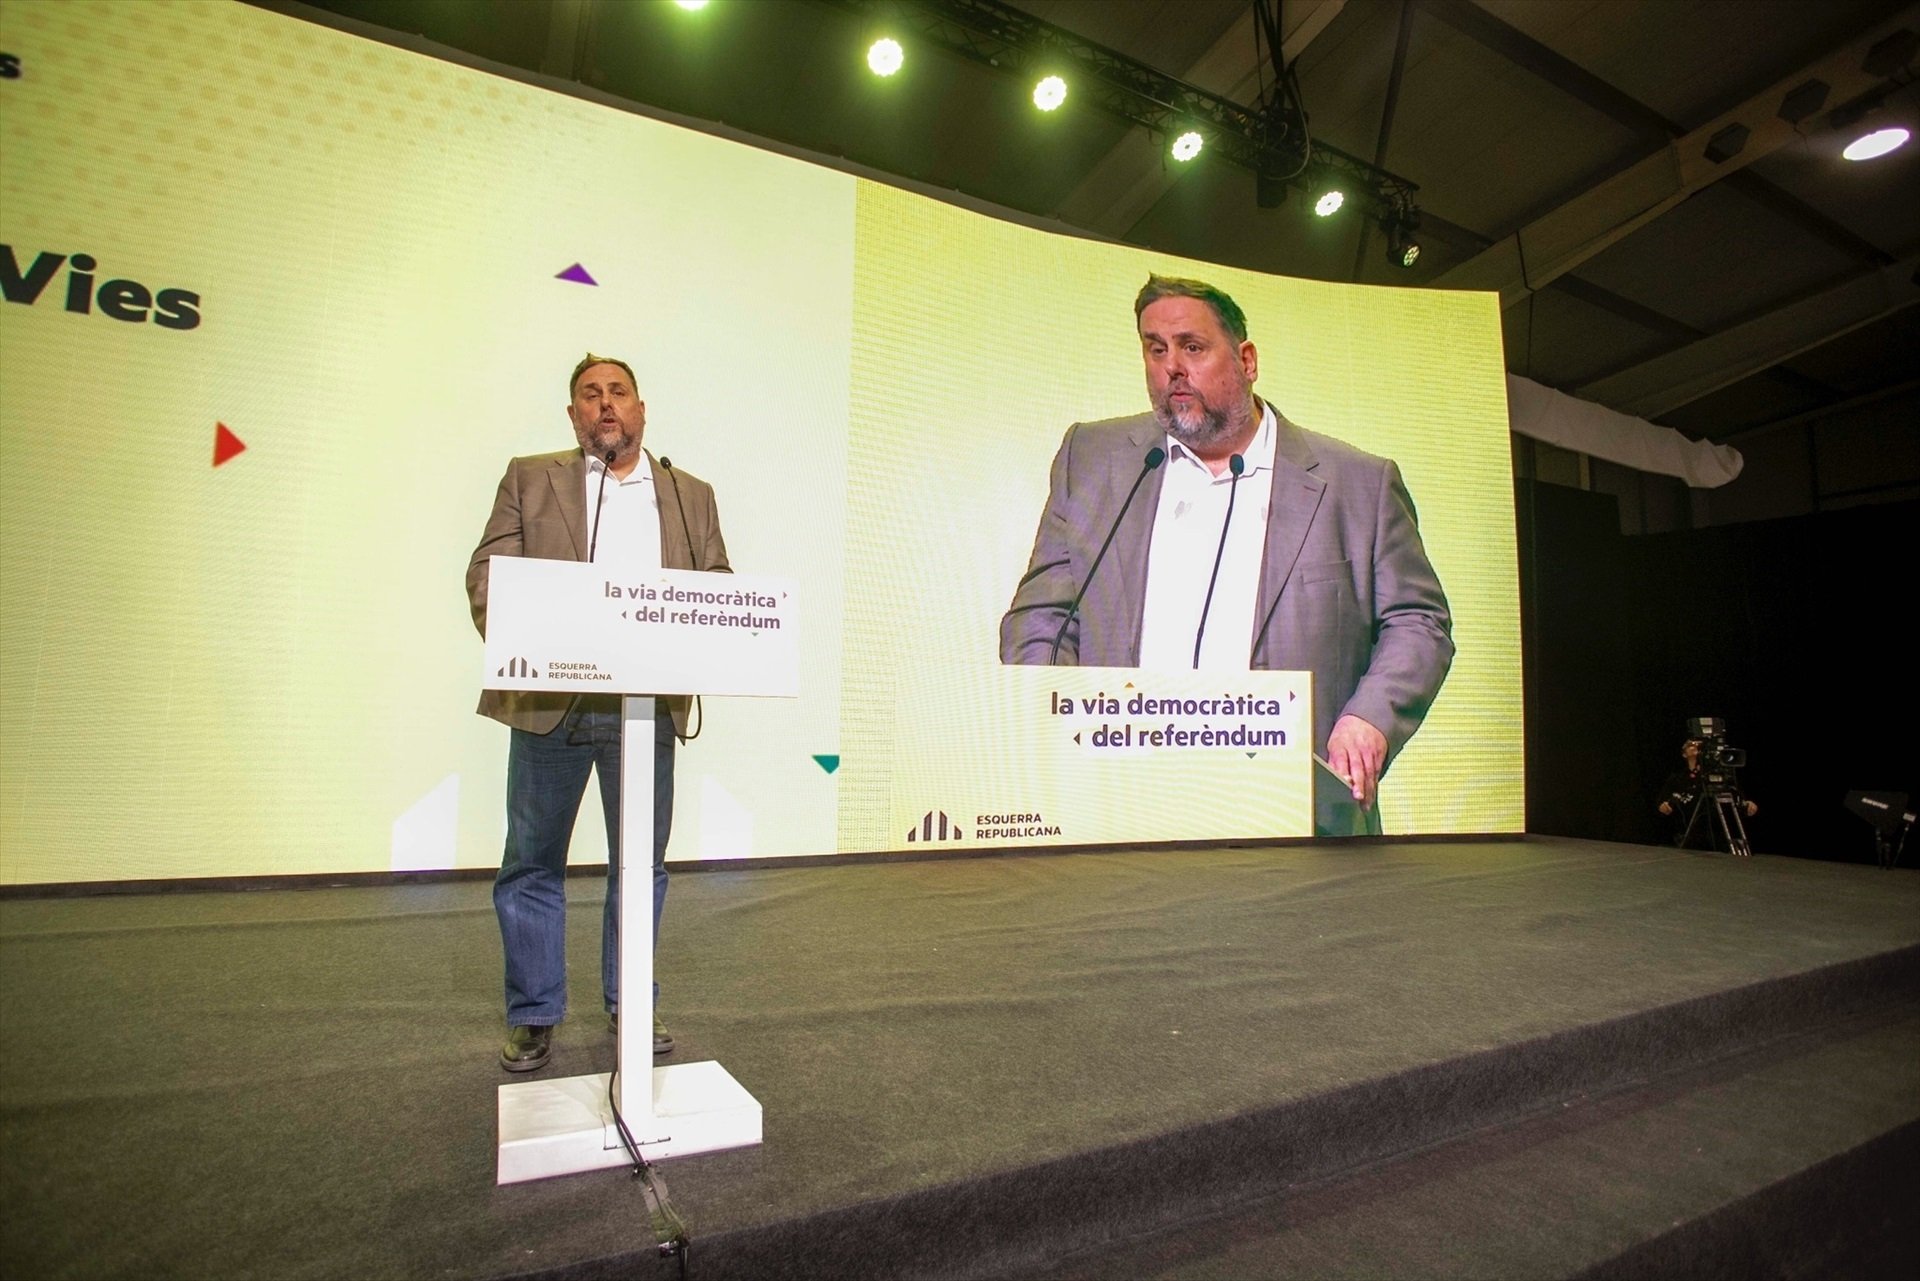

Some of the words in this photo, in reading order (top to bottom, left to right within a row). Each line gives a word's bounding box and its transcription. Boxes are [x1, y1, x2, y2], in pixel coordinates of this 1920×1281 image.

[0, 243, 201, 331] Vies
[605, 580, 622, 599] la
[627, 583, 657, 601] via
[661, 585, 777, 609] democràtica
[635, 605, 665, 623] del
[670, 608, 781, 630] referèndum
[548, 662, 598, 671] ESQUERRA
[548, 671, 613, 681] REPUBLICANA
[1051, 691, 1074, 715] la
[1081, 691, 1120, 715] via
[1127, 692, 1280, 716] democràtica
[1091, 723, 1131, 747] del
[1138, 723, 1286, 747] referèndum
[976, 813, 1042, 826] ESQUERRA
[976, 826, 1062, 839] REPUBLICANA
